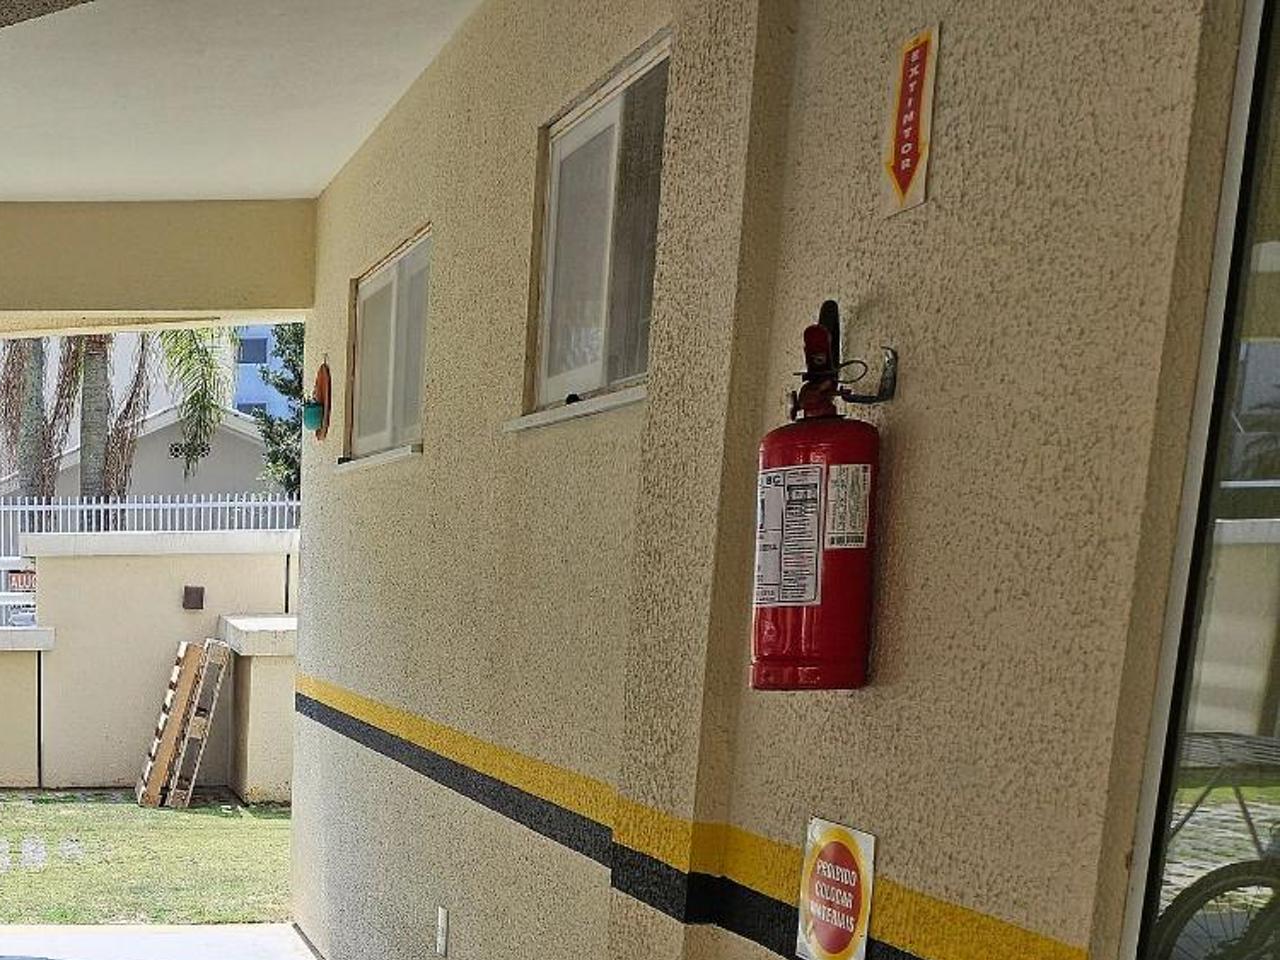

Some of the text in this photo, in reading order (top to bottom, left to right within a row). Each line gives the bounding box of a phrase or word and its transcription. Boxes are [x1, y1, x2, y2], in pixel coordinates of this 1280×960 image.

[901, 48, 920, 170] EXTINTOR
[816, 859, 857, 887] PROIBIDO
[815, 880, 853, 909] COLOCAR
